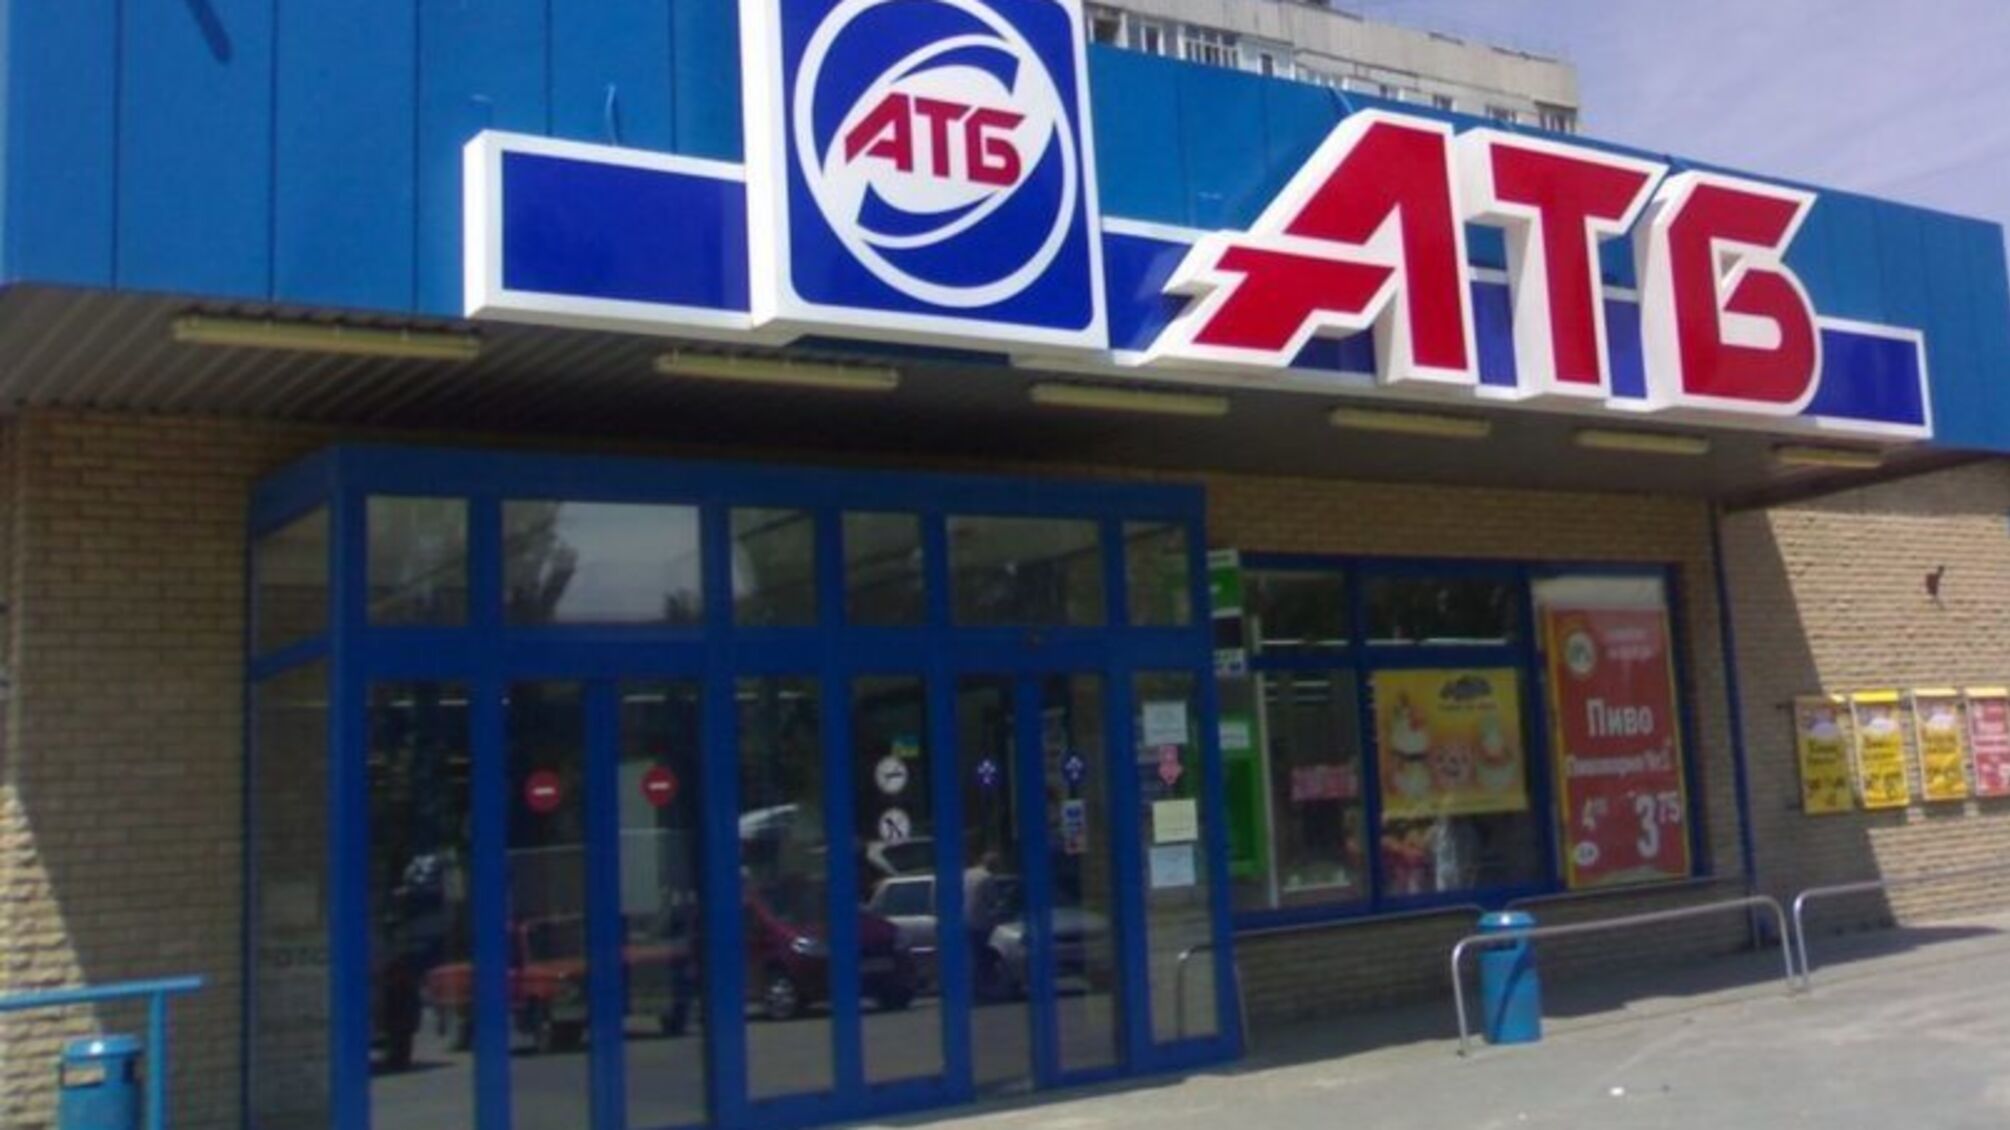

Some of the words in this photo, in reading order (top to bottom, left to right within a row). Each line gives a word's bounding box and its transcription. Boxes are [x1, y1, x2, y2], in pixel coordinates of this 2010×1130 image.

[845, 91, 1027, 188] АТБ
[1188, 118, 1820, 407] АТБ
[1586, 698, 1655, 738] Пиво
